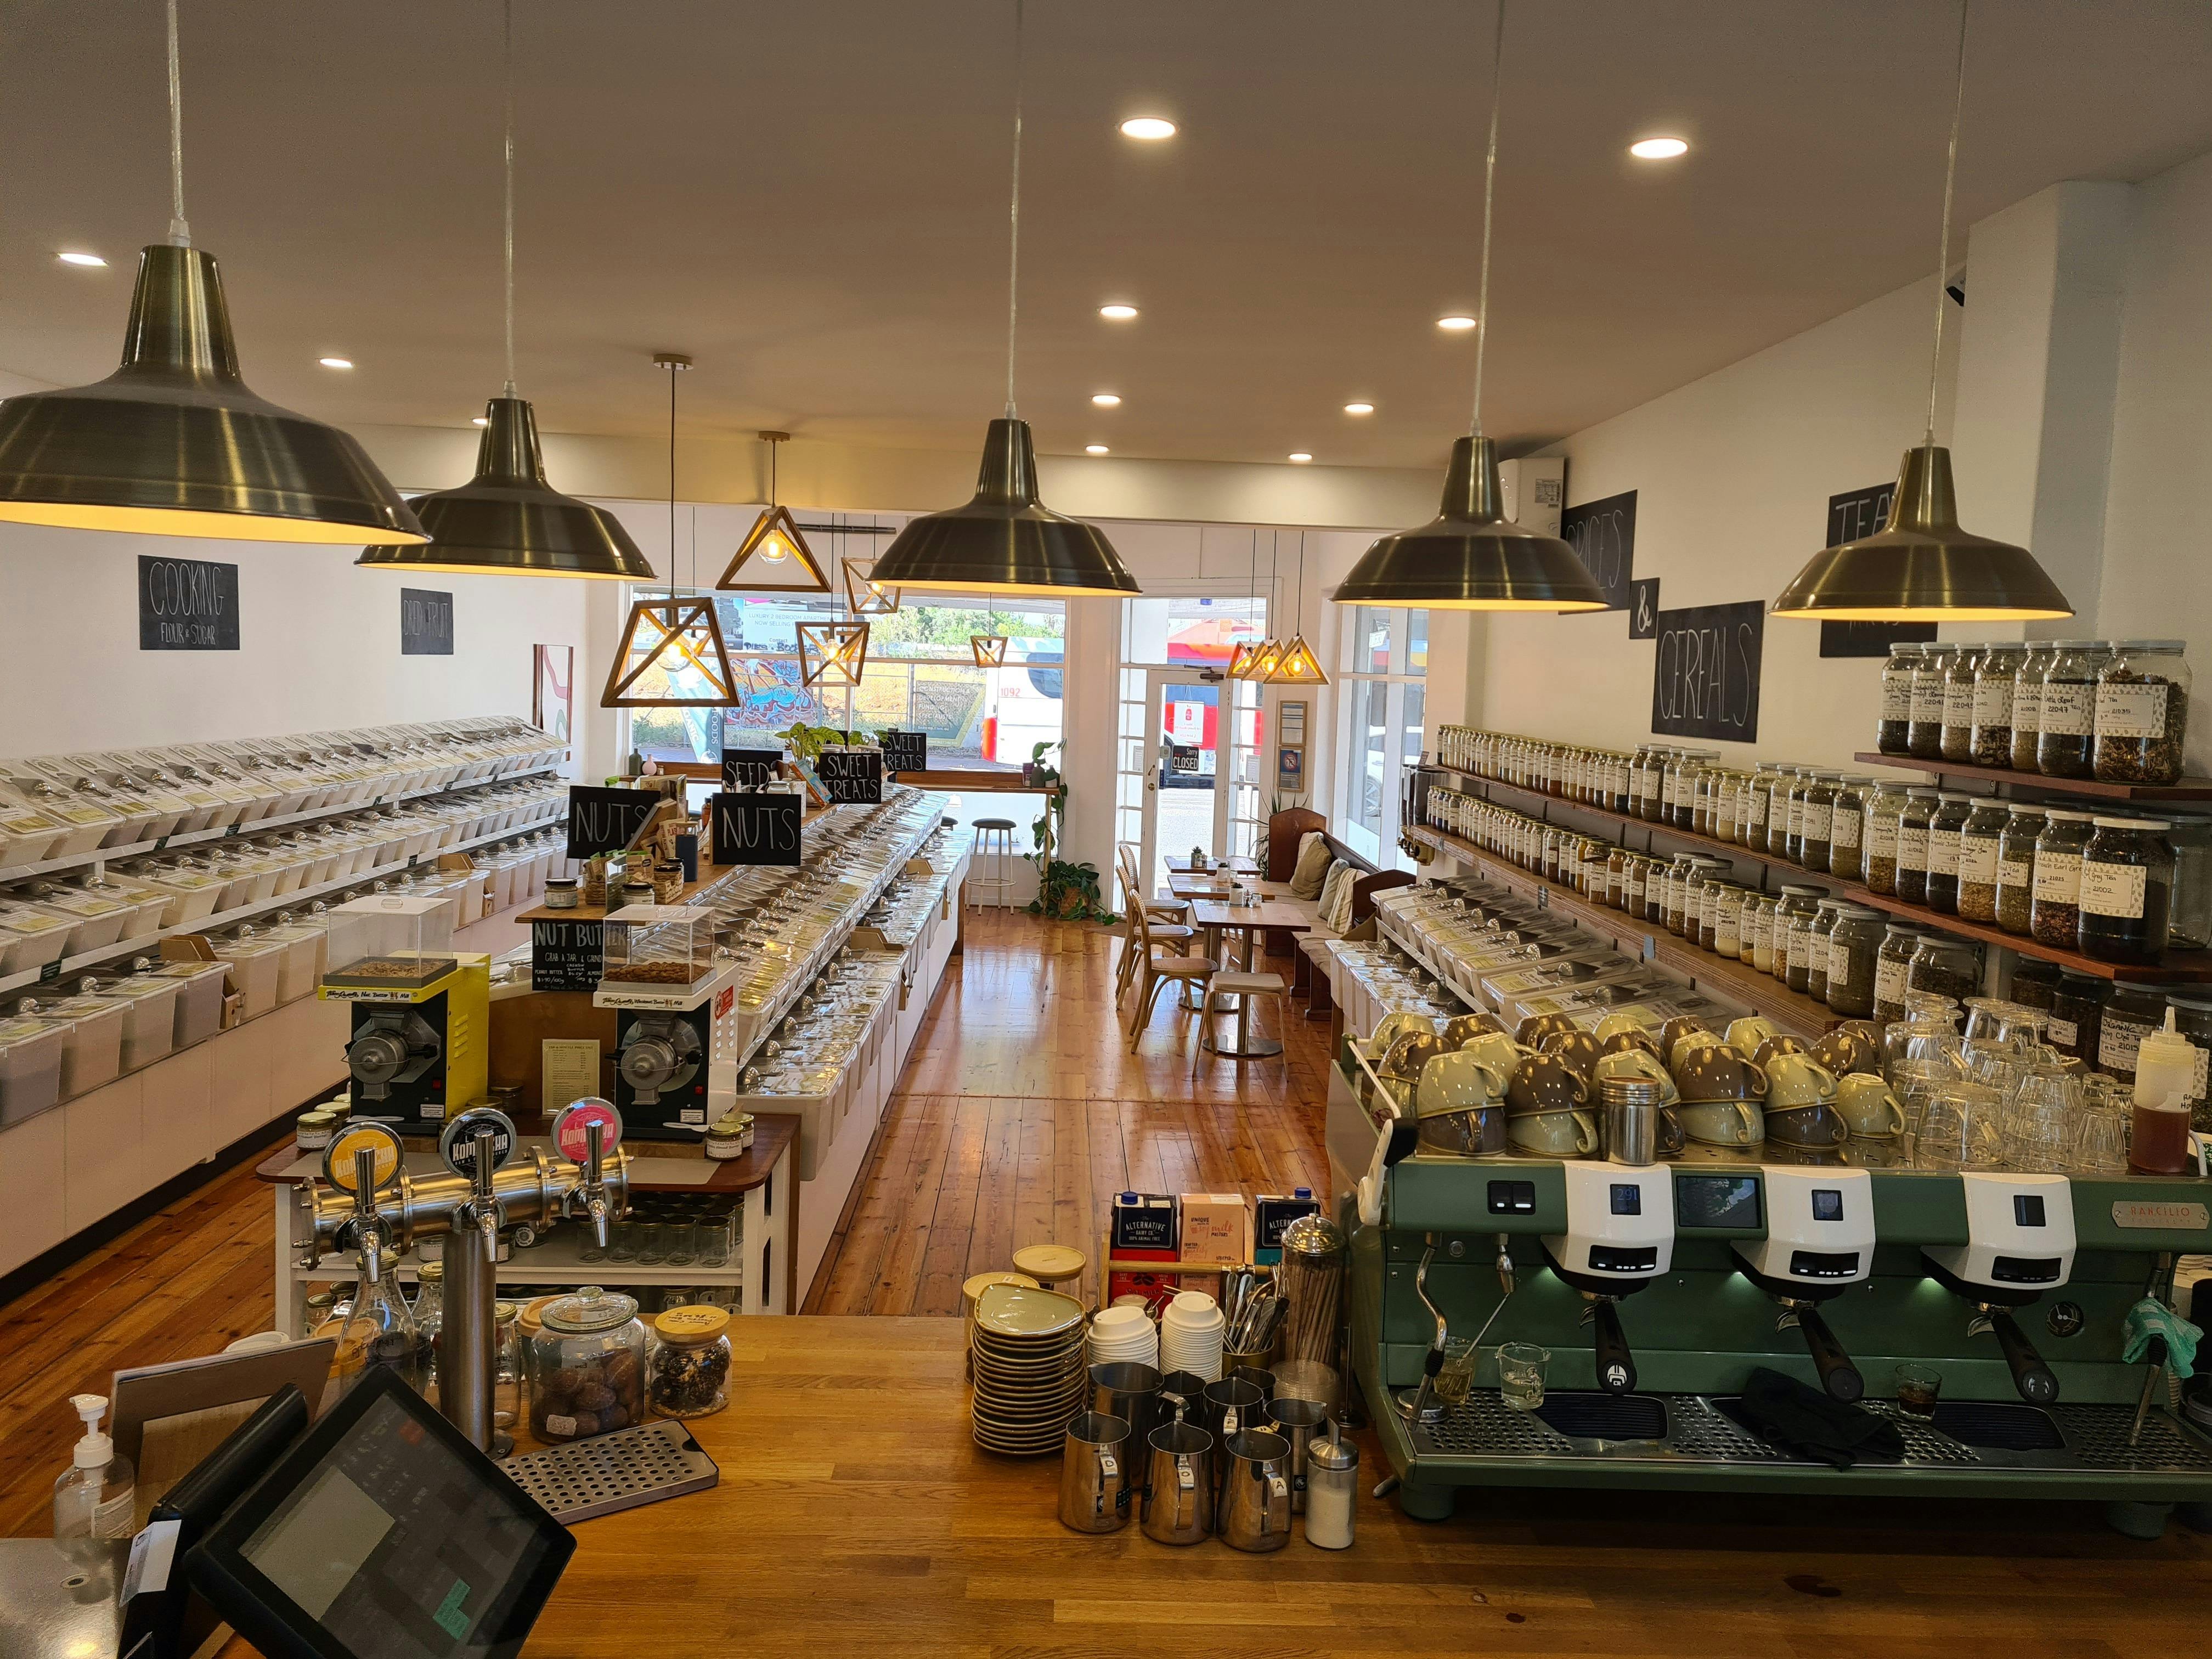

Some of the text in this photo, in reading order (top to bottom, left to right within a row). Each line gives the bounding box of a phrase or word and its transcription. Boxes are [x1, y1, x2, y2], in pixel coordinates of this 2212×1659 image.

[1566, 510, 1624, 589] PICES
[149, 561, 224, 616] COOKING
[1637, 585, 1652, 633] &
[161, 622, 216, 645] FLOUR & SUGAR
[1659, 622, 1753, 727] CEREALS
[1001, 687, 1020, 697] 1092
[884, 734, 922, 752] SWEET
[1186, 748, 1198, 758] Sorry
[827, 754, 872, 778] SWEET
[882, 754, 923, 771] TREATS
[1172, 756, 1199, 770] CLOSED
[725, 760, 776, 788] SEED
[823, 778, 879, 800] TREATS
[723, 806, 795, 851] NUTS
[2068, 864, 2083, 872] Gre
[534, 922, 627, 947] NUT BUTTER
[545, 952, 559, 962] GRAB
[561, 953, 565, 962] A
[567, 952, 577, 962] JAR
[586, 955, 602, 963] GRIND
[2130, 1206, 2190, 1216] RANCILIO
[1126, 1221, 1166, 1232] ALTERNATIVE
[1211, 1220, 1234, 1232] milk
[1276, 1481, 1285, 1489] A
